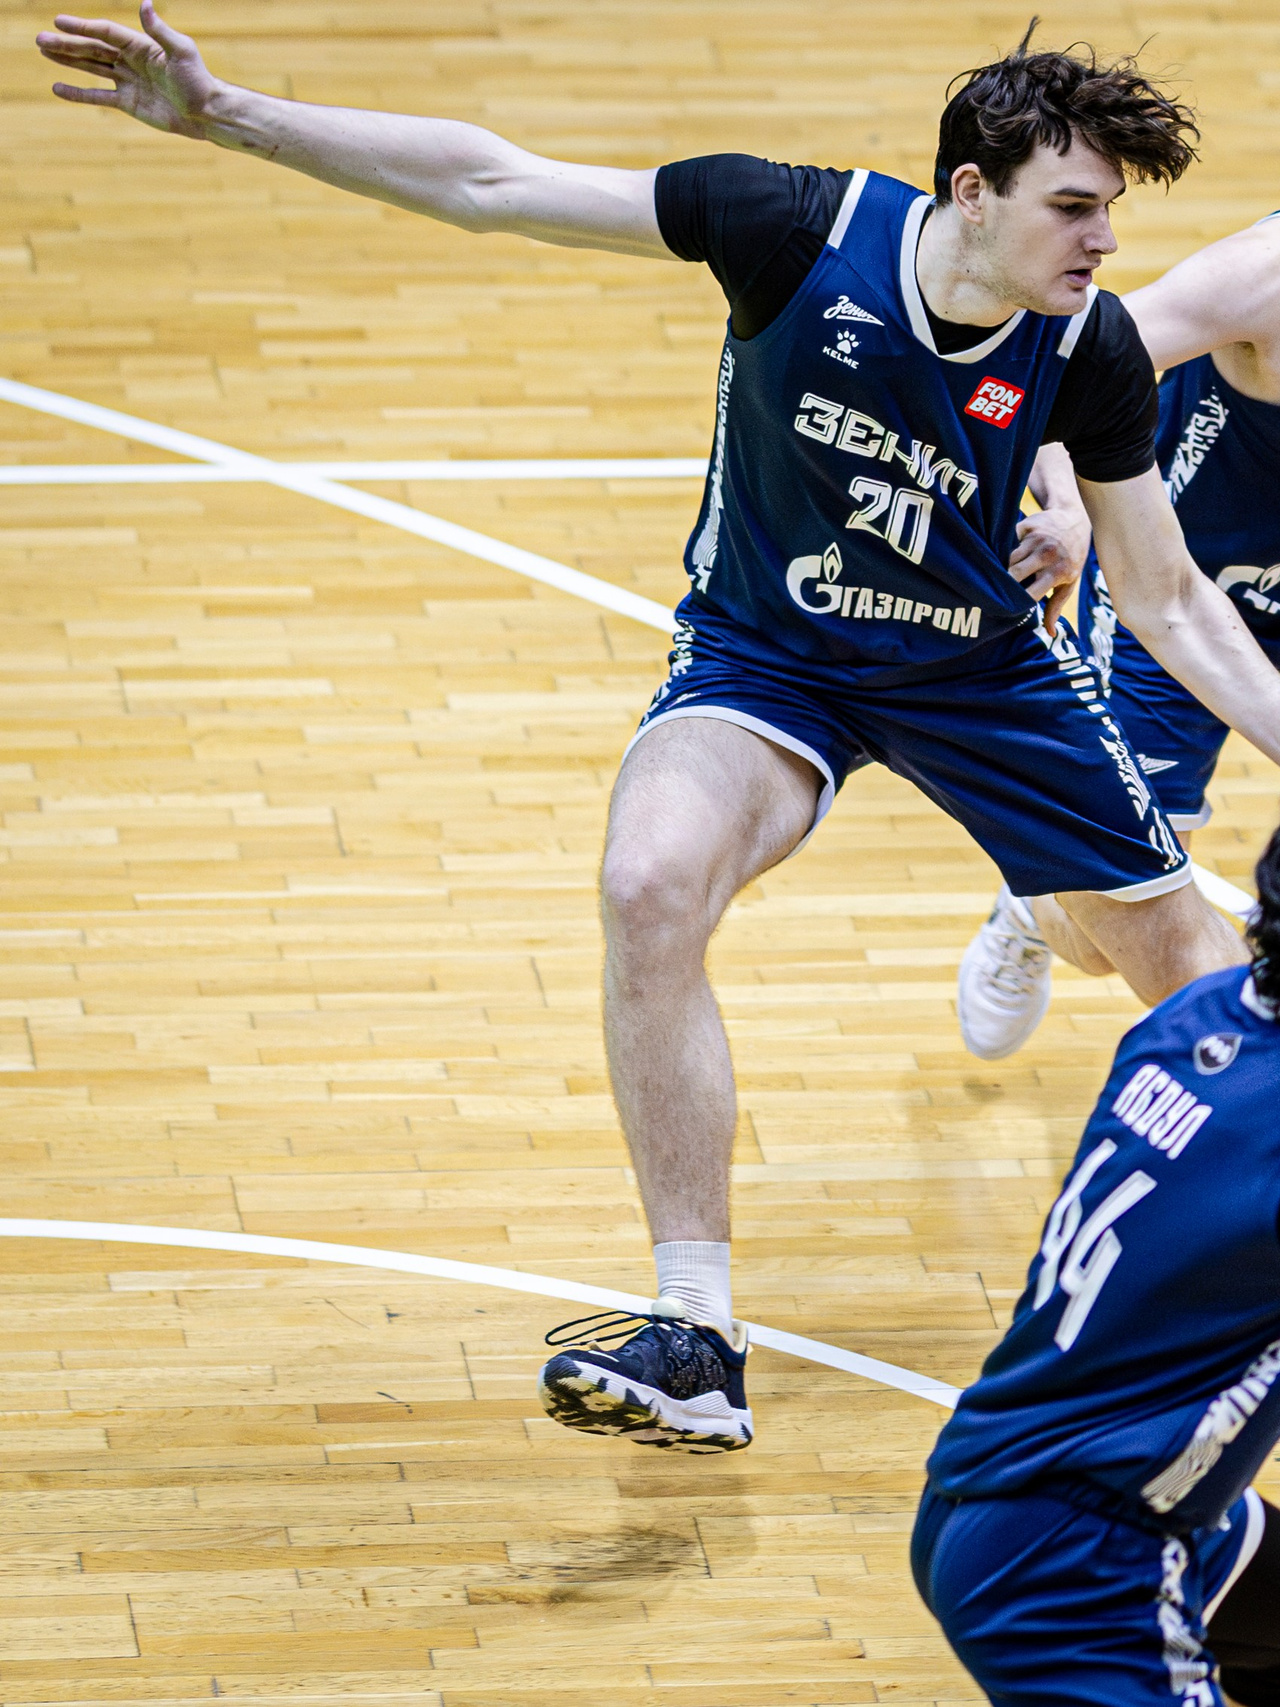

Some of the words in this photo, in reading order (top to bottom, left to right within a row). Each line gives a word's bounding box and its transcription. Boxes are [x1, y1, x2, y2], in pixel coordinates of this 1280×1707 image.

[823, 346, 859, 369] KELME
[969, 396, 1014, 420] BET
[977, 382, 1021, 407] FON
[794, 392, 979, 508] ЗЕНИТ
[845, 475, 934, 565] 20
[1033, 1137, 1158, 1353] 44
